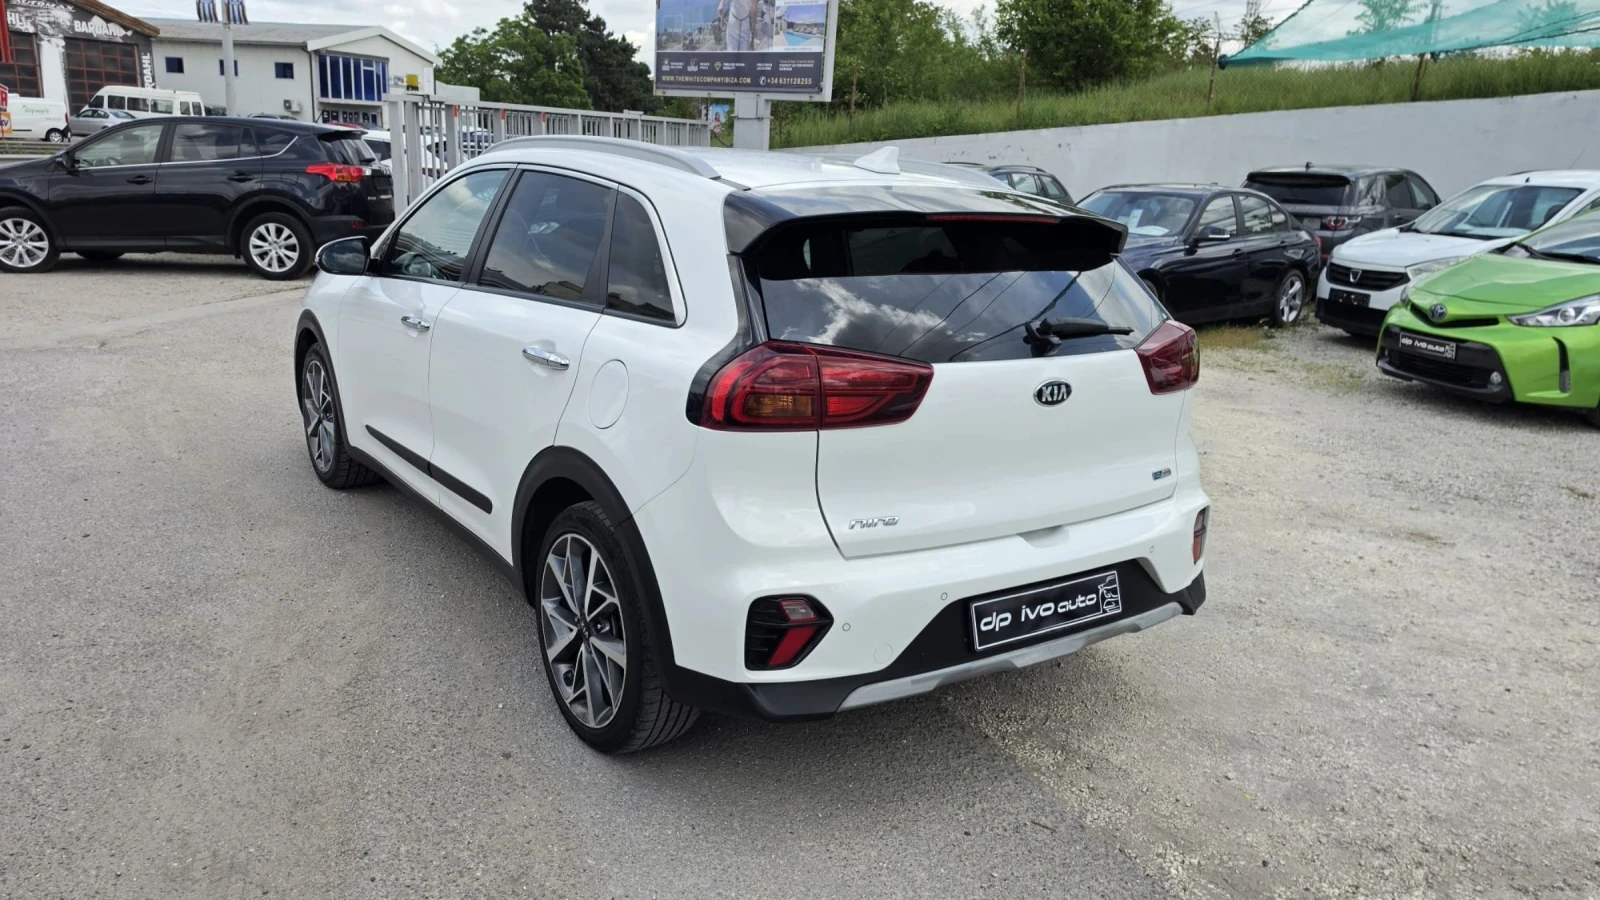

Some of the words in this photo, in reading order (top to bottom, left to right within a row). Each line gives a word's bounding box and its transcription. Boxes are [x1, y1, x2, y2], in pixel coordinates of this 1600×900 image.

[74, 20, 123, 37] BARDAHL
[141, 52, 155, 89] RDAHL
[1041, 384, 1068, 402] KIA
[980, 612, 1012, 632] dp
[1020, 602, 1055, 622] ivo
[1057, 593, 1097, 613] auto
